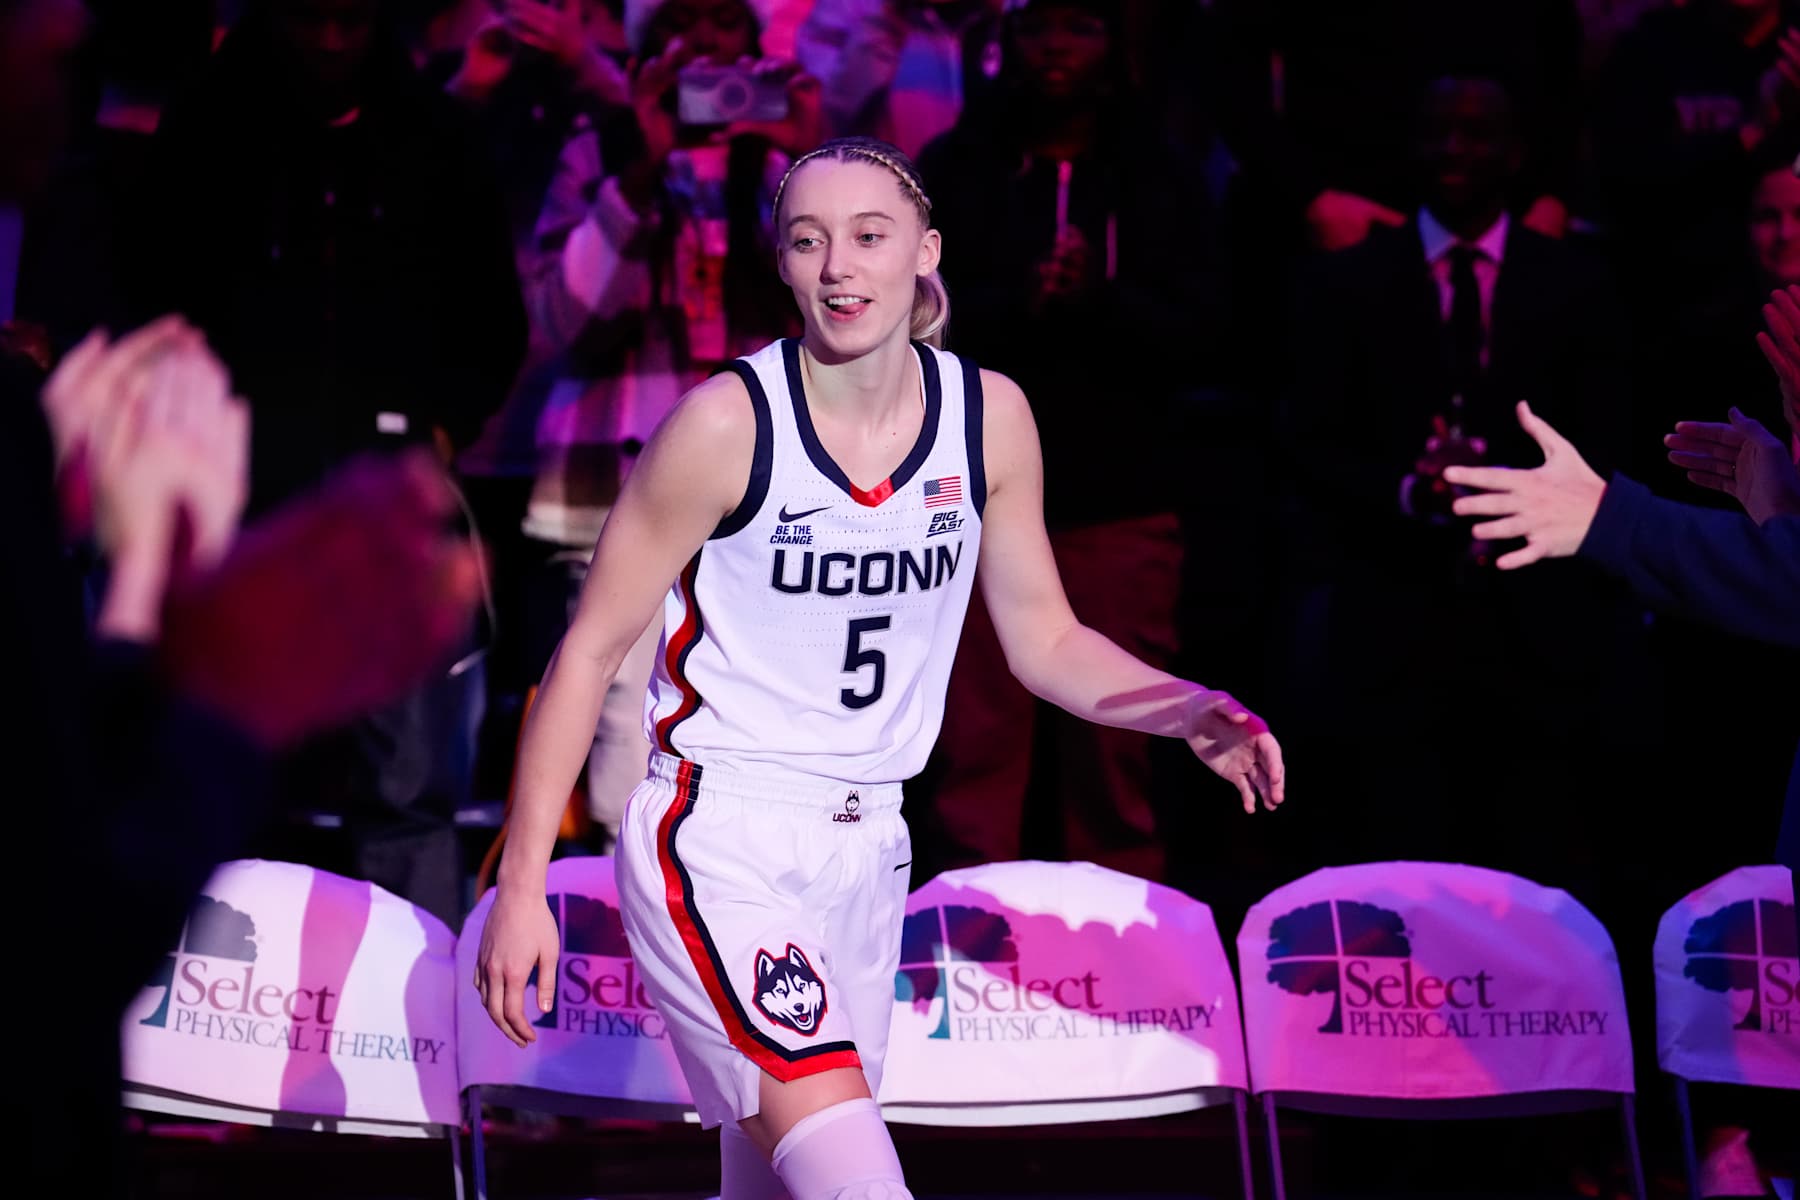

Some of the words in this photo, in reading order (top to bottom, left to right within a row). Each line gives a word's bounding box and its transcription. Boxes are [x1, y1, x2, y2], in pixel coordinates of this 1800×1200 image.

[775, 525, 789, 535] BE
[793, 525, 812, 535] THE
[928, 518, 964, 532] EAST
[932, 511, 959, 522] BIG
[769, 535, 813, 545] CHANGE
[770, 541, 963, 596] UCONN
[840, 614, 892, 711] 5
[832, 813, 861, 822] UCONN
[176, 960, 335, 1025] Select
[953, 966, 1102, 1013] Select
[1344, 960, 1496, 1010] Select
[174, 1007, 309, 1052] PHYSICAL
[315, 1026, 446, 1065] THERAPY
[957, 1015, 1088, 1042] PHYSICAL
[1098, 1005, 1215, 1037] THERAPY
[1348, 1010, 1480, 1039] PHYSICAL
[1486, 1009, 1608, 1037] THERAPY
